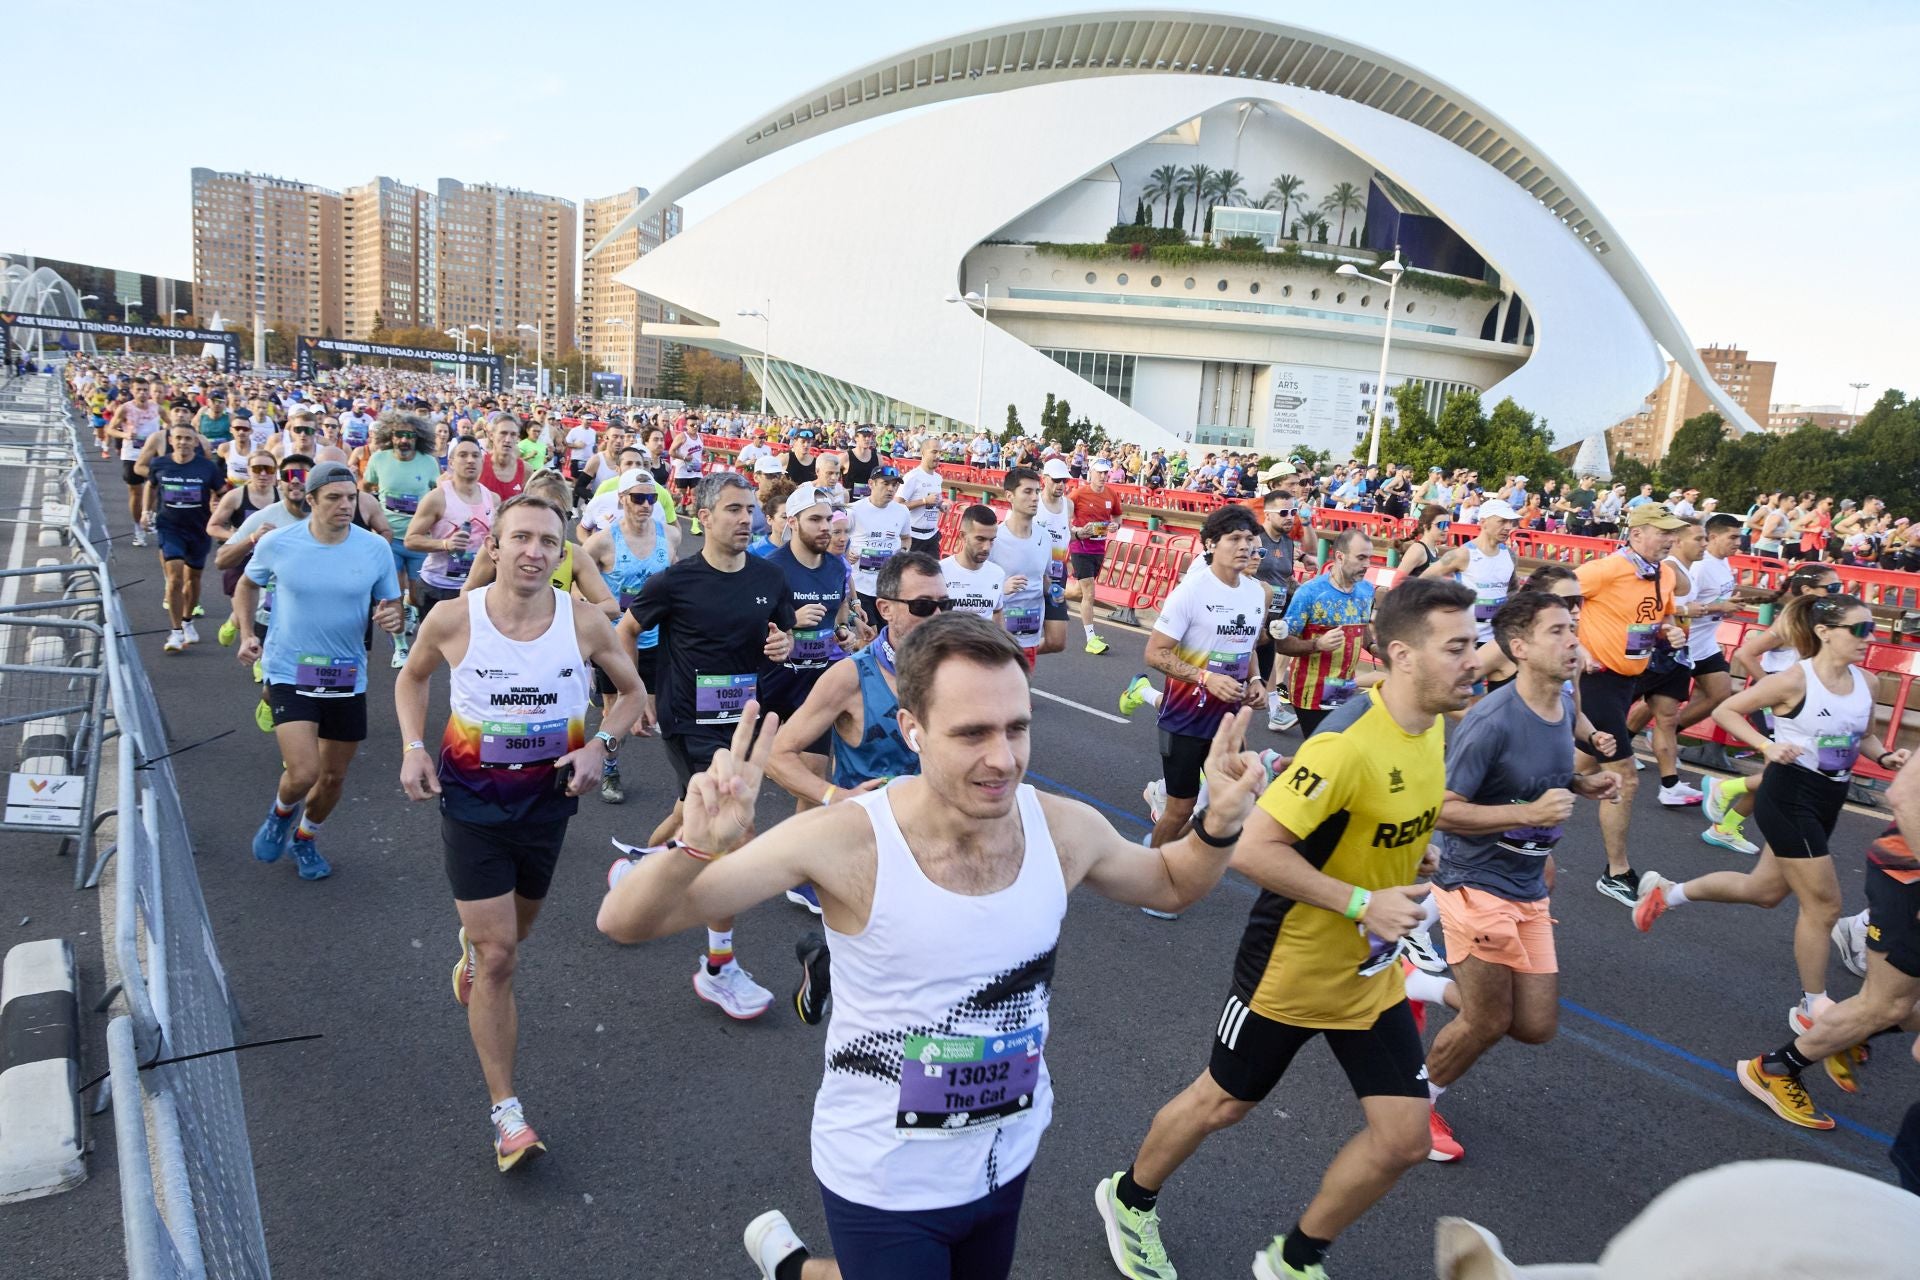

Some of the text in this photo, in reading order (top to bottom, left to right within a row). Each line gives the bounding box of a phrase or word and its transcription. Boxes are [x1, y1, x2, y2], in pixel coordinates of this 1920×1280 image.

[35, 318, 80, 329] VALENCIA
[81, 322, 132, 334] TRINIDAD
[133, 327, 185, 338] ALFONSO
[334, 342, 370, 353] VALENCIA
[371, 346, 414, 357] TRINIDAD
[414, 350, 457, 361] ALFONSO
[1279, 372, 1293, 380] LES
[1278, 381, 1298, 390] ARTS
[794, 592, 819, 600] Nordés
[954, 599, 993, 607] MARATHON
[1217, 625, 1256, 635] MARATHON
[316, 668, 341, 676] 10921
[490, 693, 558, 705] MARATHON
[716, 688, 743, 699] 10920
[506, 737, 545, 749] 36015
[948, 1061, 1010, 1086] 13032
[944, 1087, 1006, 1109] The Cat
